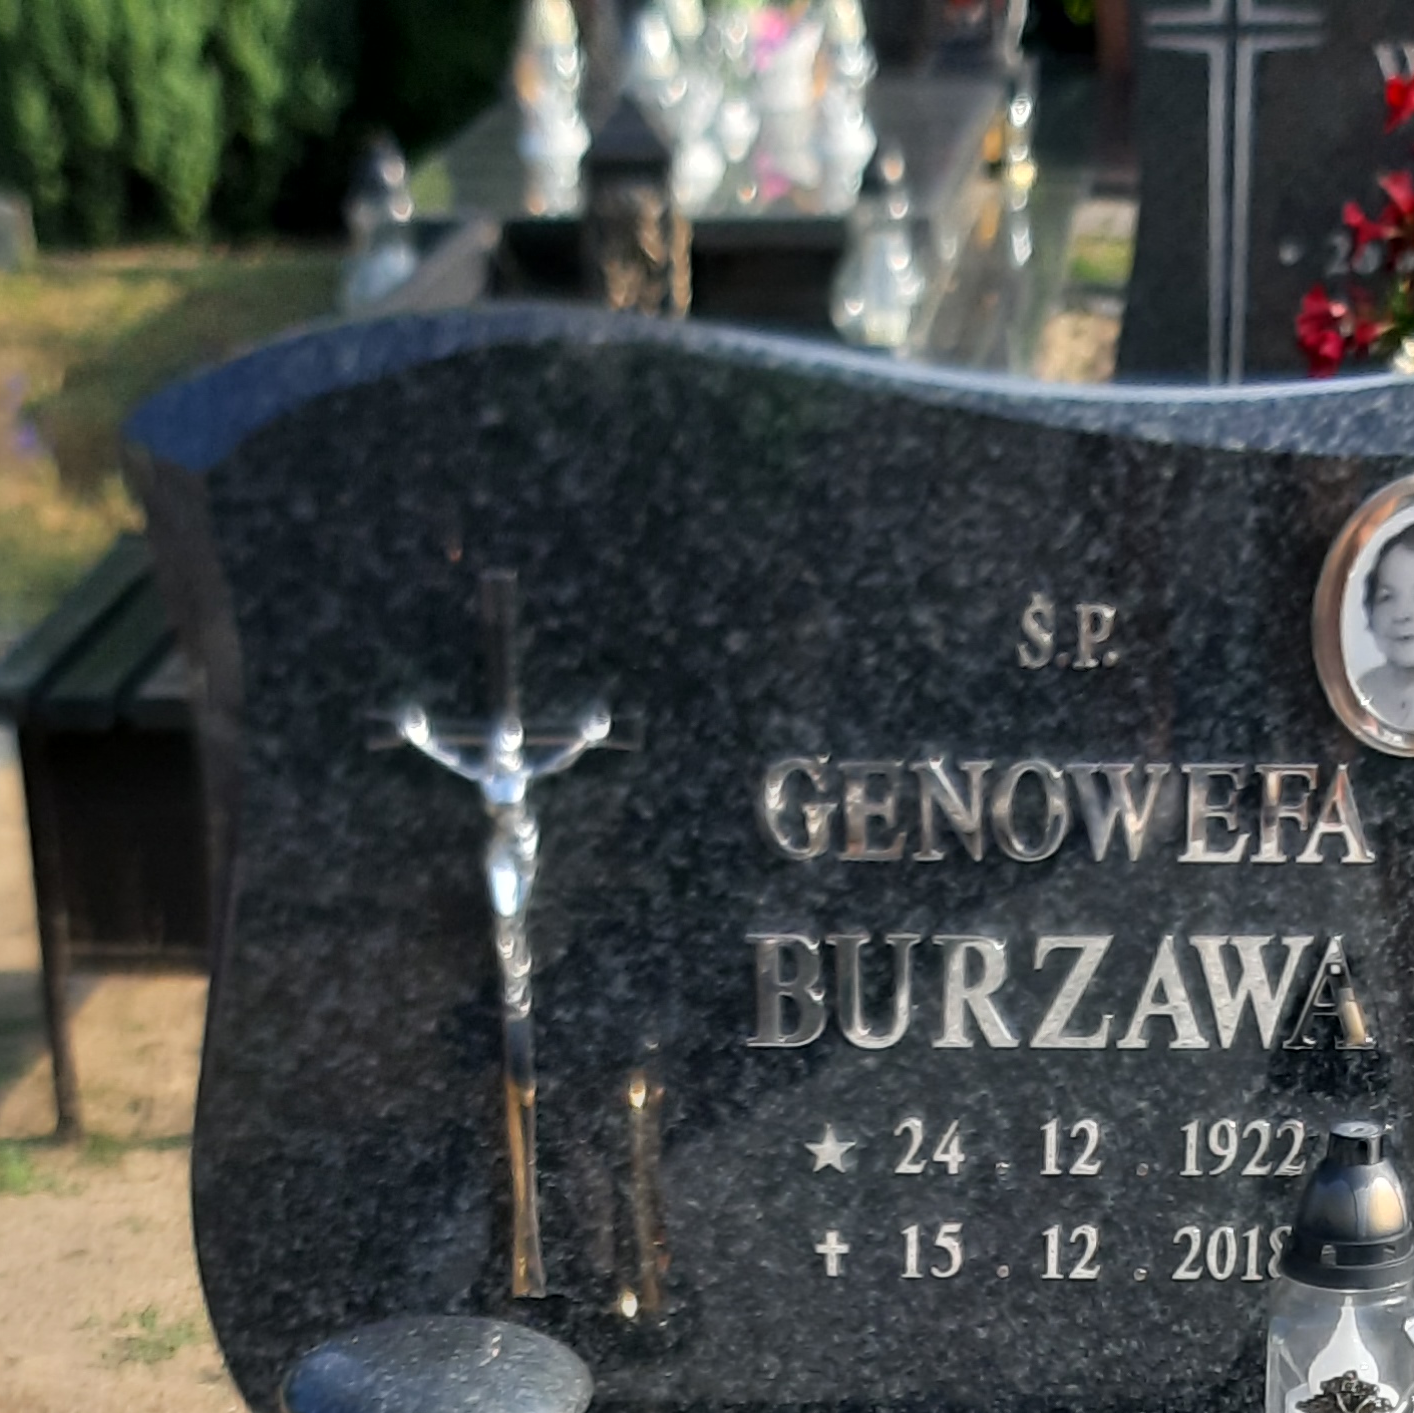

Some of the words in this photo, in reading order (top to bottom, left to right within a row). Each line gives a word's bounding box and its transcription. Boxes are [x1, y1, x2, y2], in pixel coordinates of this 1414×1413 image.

[762, 755, 1376, 864] GENOWEFA
[745, 932, 1377, 1051] BURZAWA
[893, 1116, 966, 1176] 24
[1039, 1117, 1102, 1177] 12
[1179, 1117, 1307, 1178] 1922
[900, 1221, 964, 1280] 15
[1040, 1223, 1102, 1281] 12
